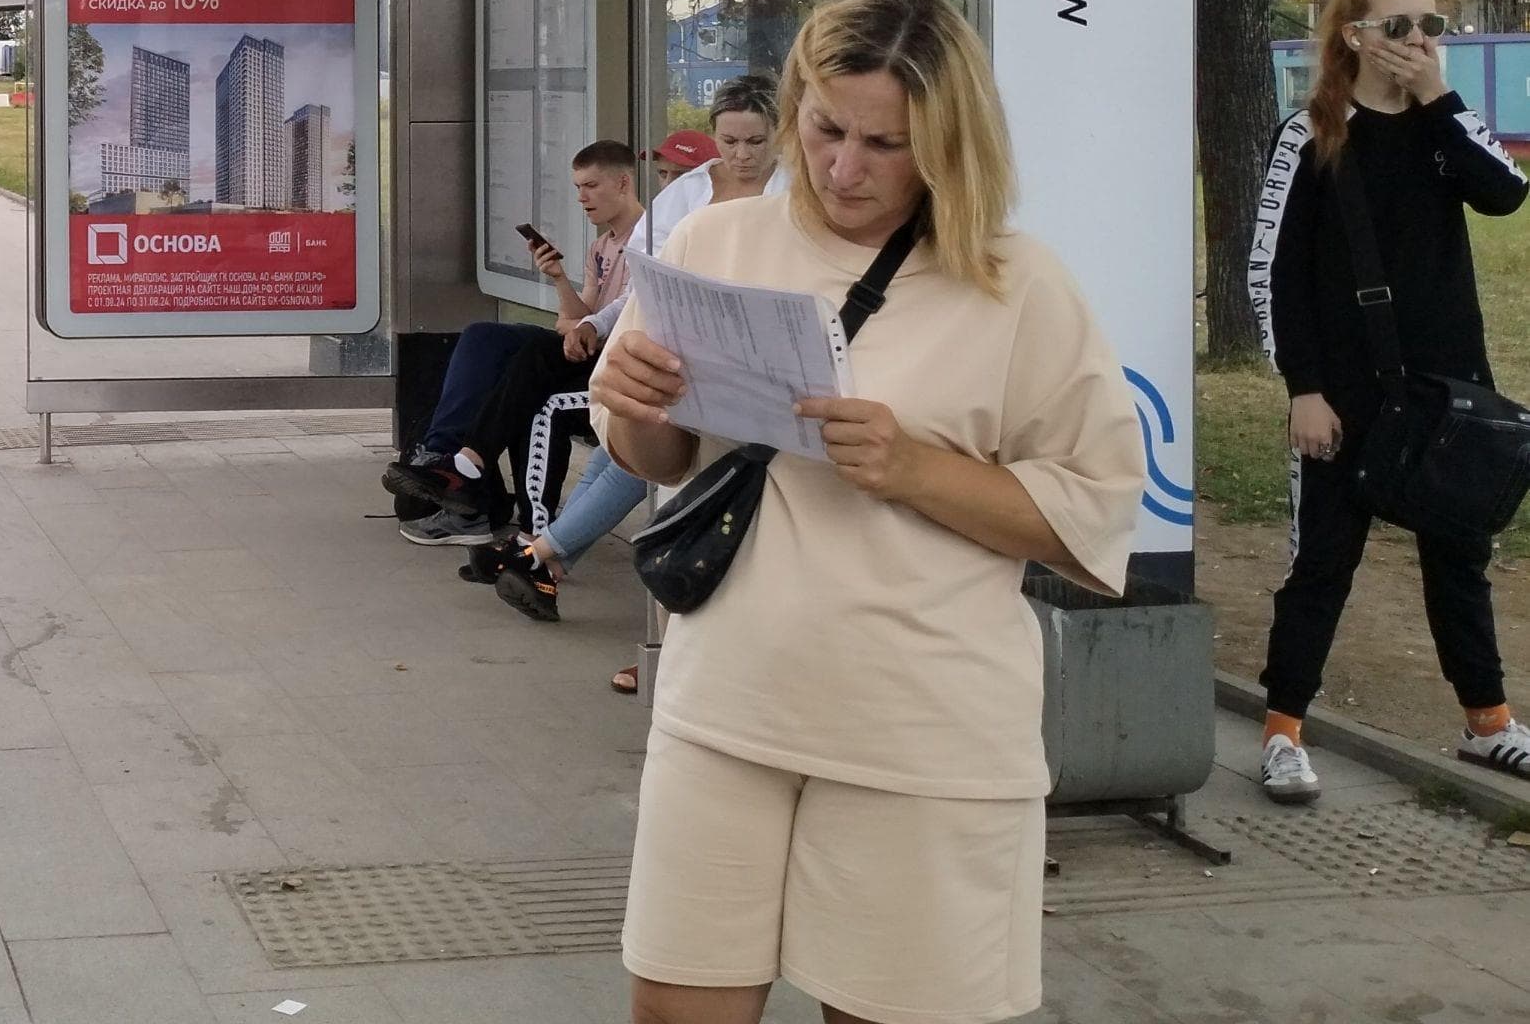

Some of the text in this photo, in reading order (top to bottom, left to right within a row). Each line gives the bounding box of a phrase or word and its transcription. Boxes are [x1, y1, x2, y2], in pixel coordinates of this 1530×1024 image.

[149, 0, 167, 12] до
[1257, 121, 1309, 230] JORDAN
[134, 234, 222, 254] ОСНОВА
[305, 239, 327, 247] БАНК
[185, 284, 195, 294] НА
[197, 283, 221, 294] САЙТЕ
[275, 284, 294, 294] СРОК
[230, 296, 241, 305] НА
[242, 294, 266, 306] САЙТЕ
